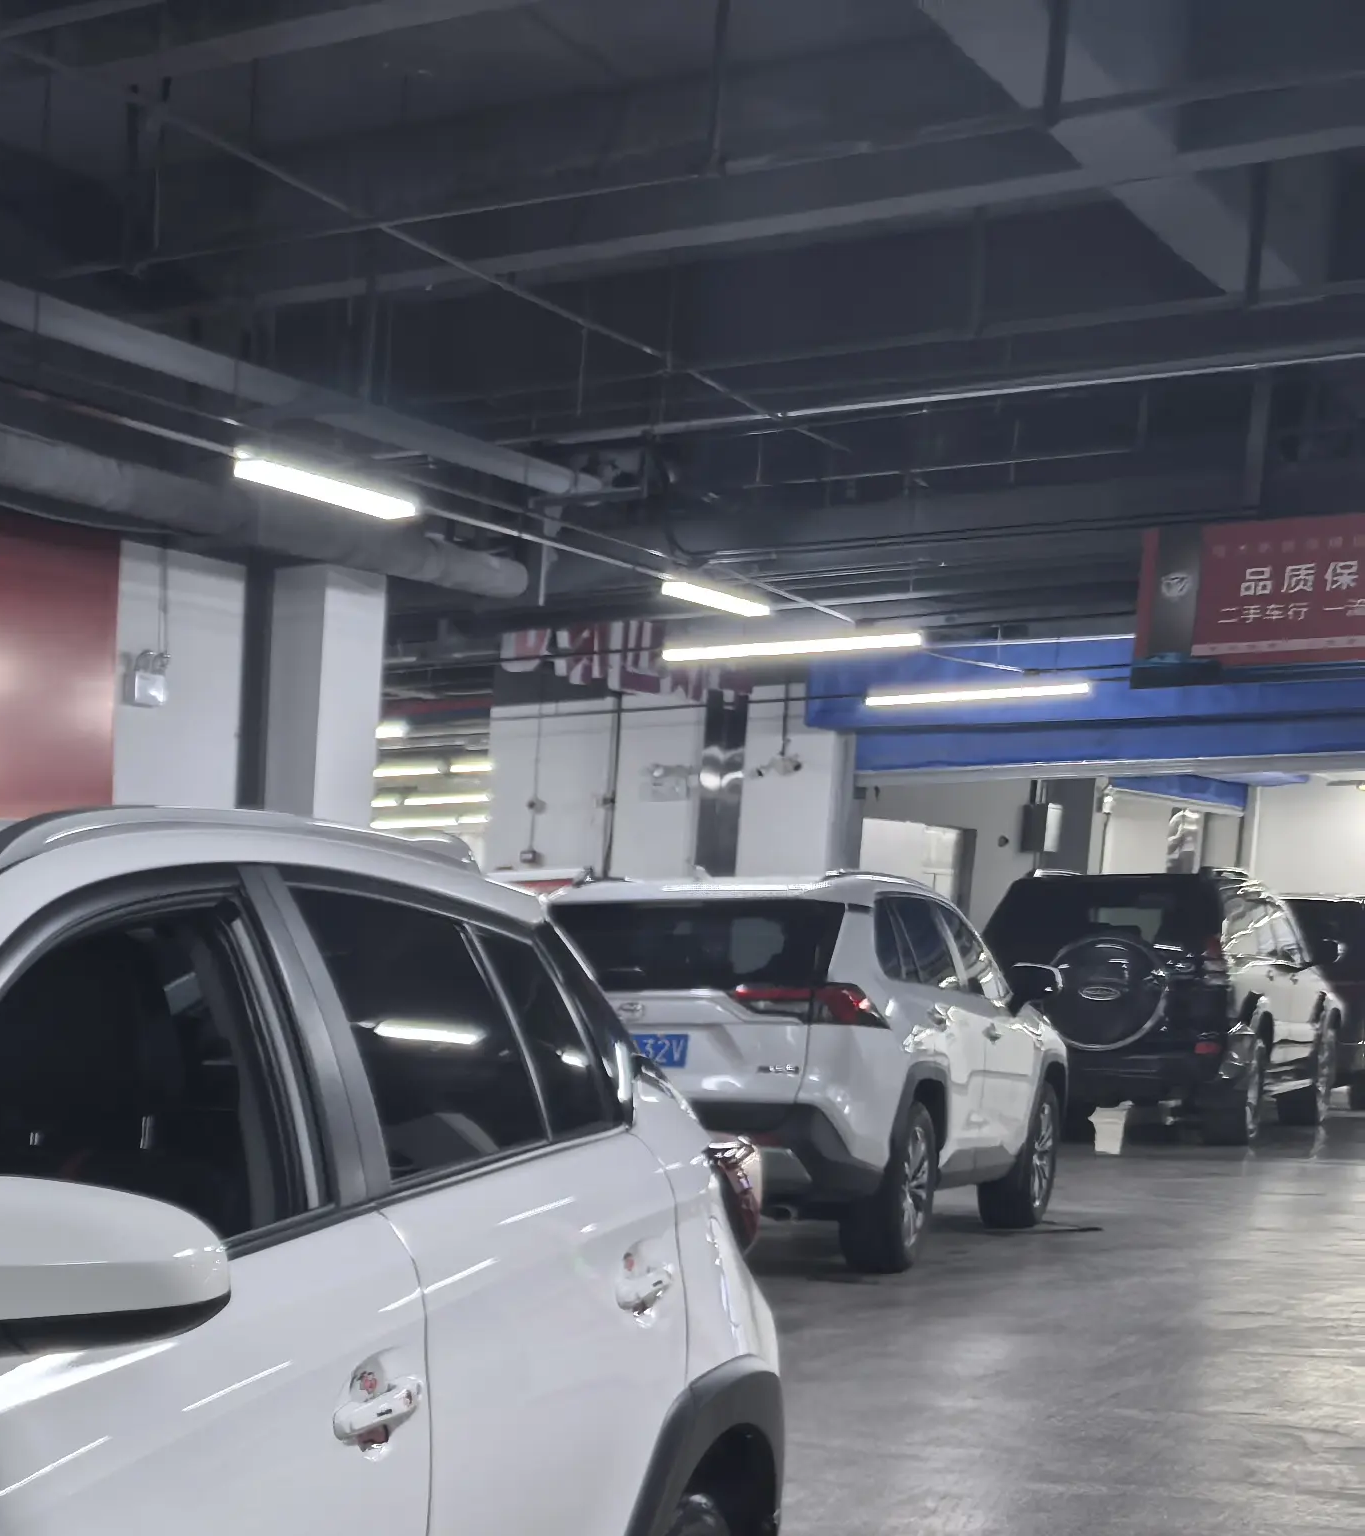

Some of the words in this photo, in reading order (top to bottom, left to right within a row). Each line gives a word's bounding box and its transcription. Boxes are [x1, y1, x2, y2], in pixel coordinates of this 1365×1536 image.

[1240, 560, 1360, 597] 品质保
[1217, 601, 1311, 623] 二手车行
